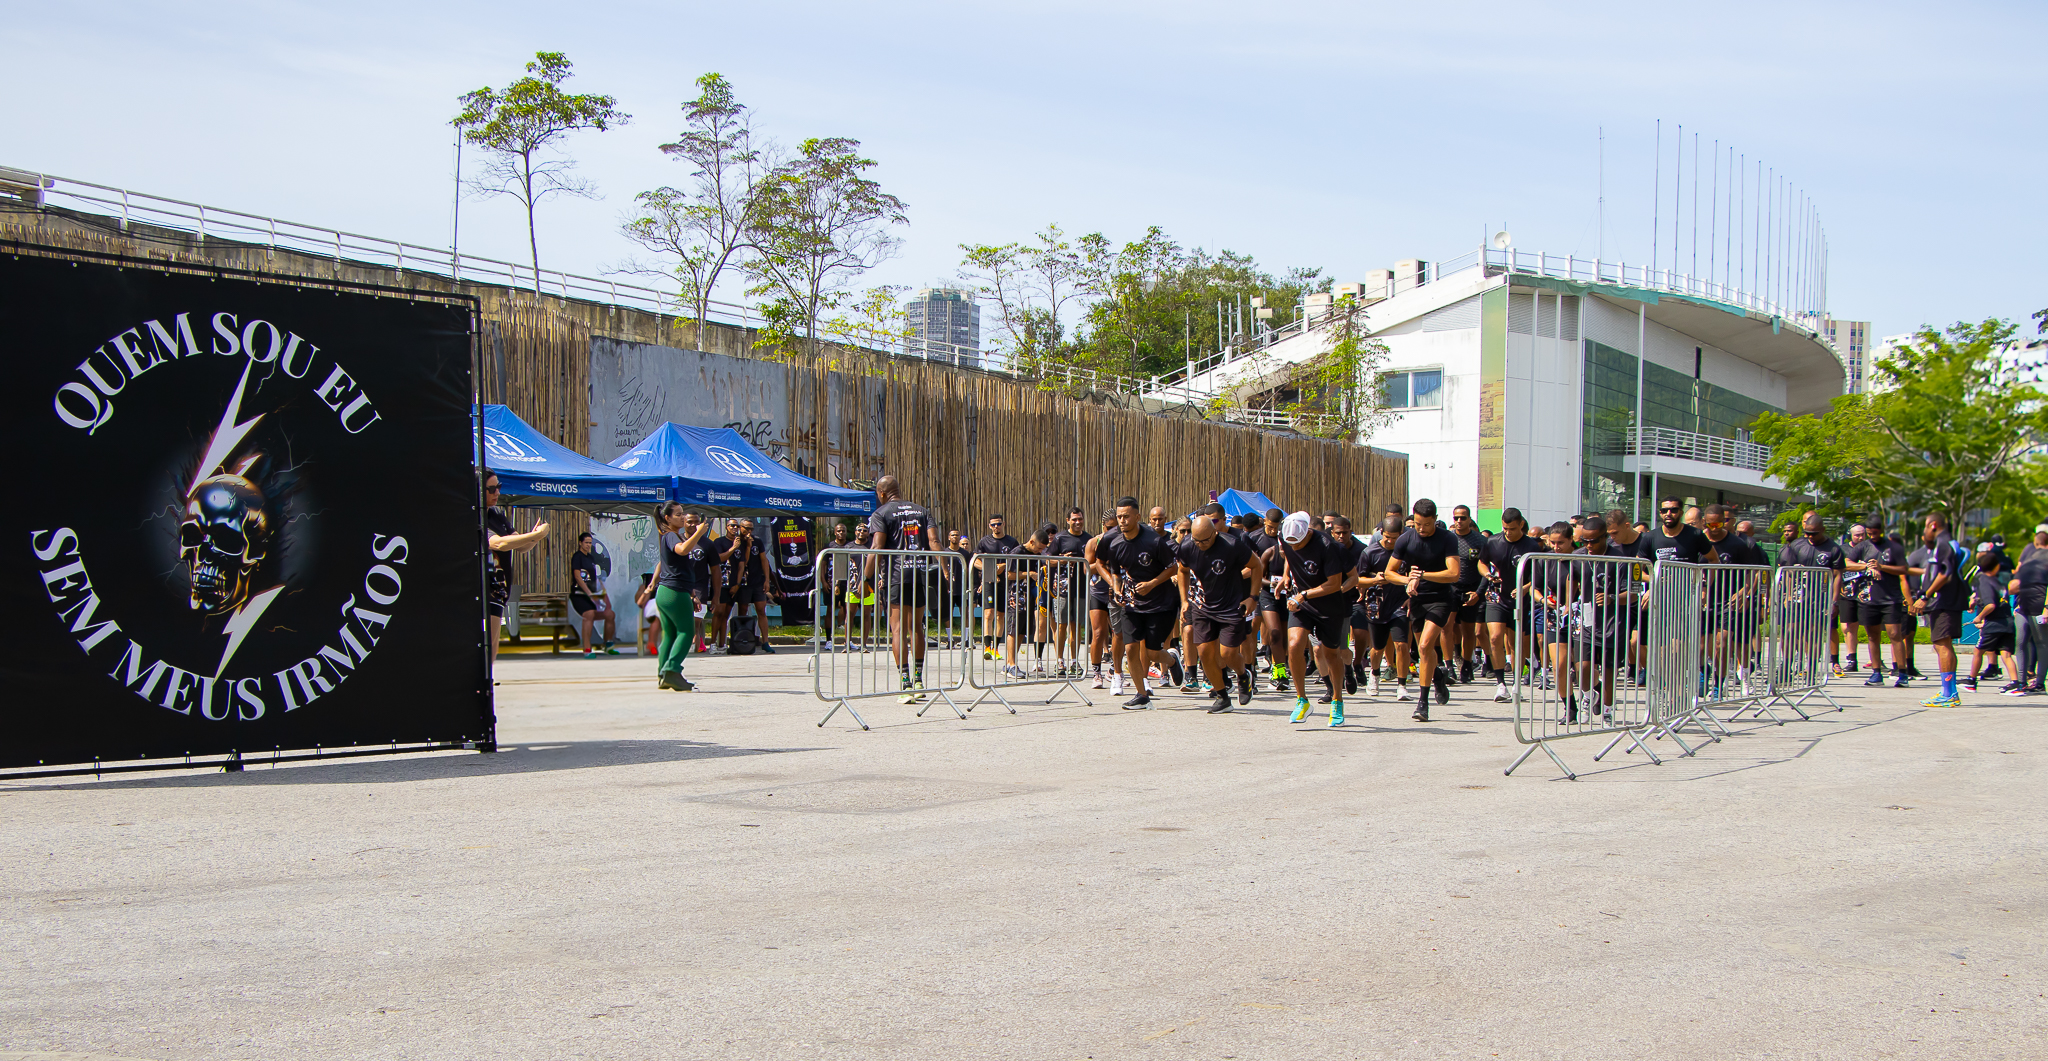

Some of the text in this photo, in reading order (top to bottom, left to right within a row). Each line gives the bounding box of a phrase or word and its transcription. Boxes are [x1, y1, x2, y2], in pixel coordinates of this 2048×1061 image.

[54, 311, 382, 436] QUEM SOU EU
[709, 451, 754, 473] RJ
[31, 527, 409, 722] SEM MEUS IRMÃOS
